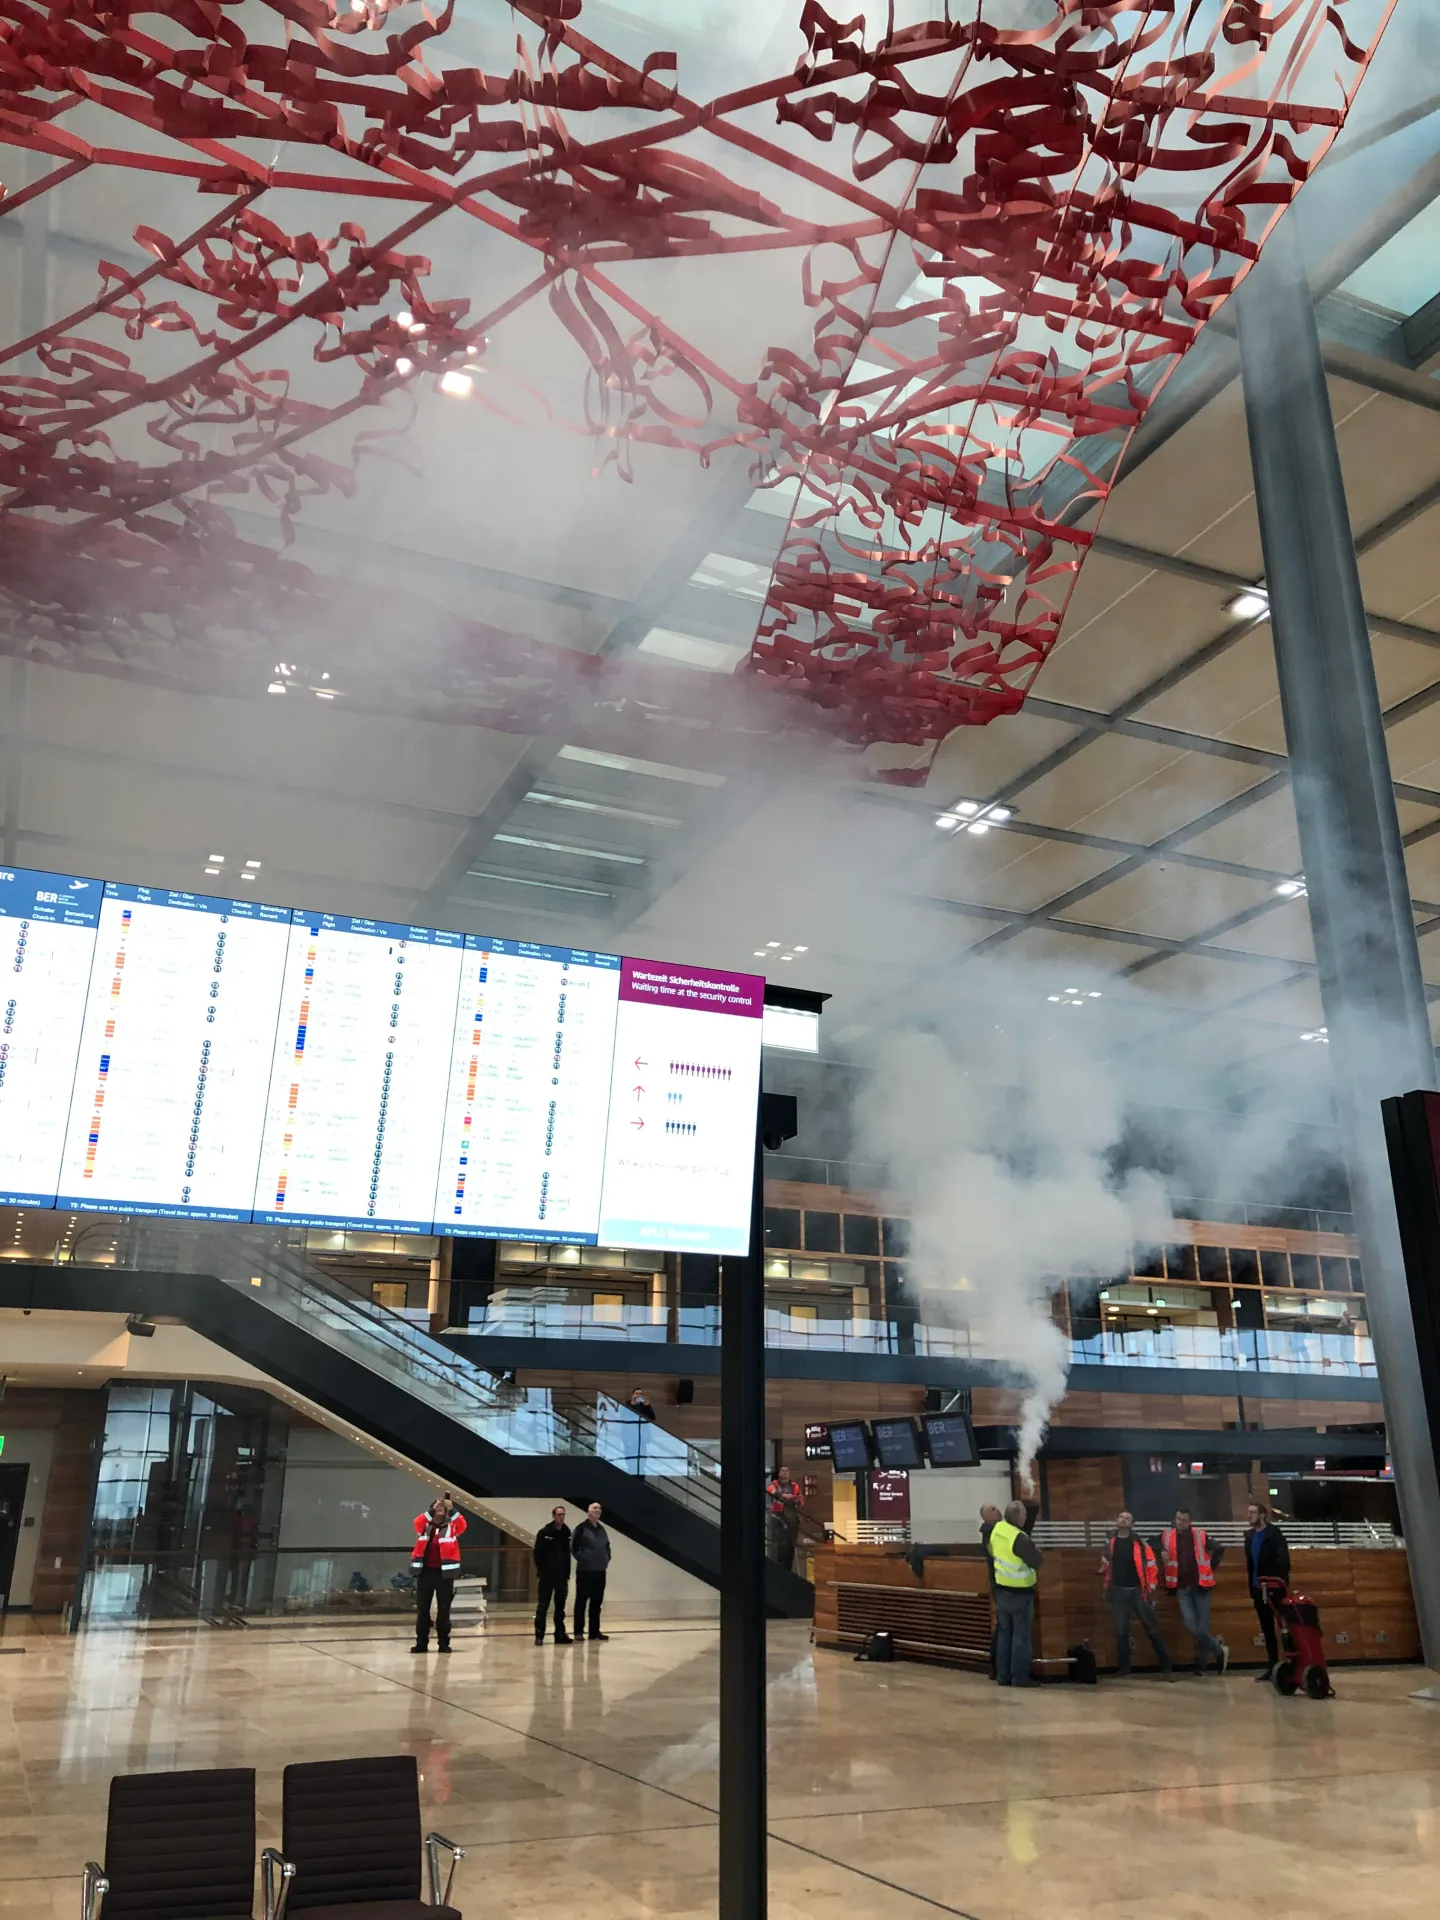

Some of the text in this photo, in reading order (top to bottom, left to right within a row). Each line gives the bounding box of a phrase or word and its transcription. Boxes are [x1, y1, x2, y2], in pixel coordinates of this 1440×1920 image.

[0, 872, 15, 882] re
[36, 890, 58, 903] BER
[168, 899, 195, 908] Destination
[33, 906, 55, 914] Schalter
[64, 910, 94, 920] Bemerkung
[231, 908, 252, 916] Check-in
[32, 913, 55, 921] Check-in
[64, 917, 84, 925] Remark
[632, 971, 740, 992] Wartezeit Sicherheitskontrolle
[632, 982, 658, 994] Waiting
[660, 986, 676, 995] time
[686, 989, 698, 998] the
[700, 992, 727, 1003] security
[728, 995, 752, 1005] control
[927, 1422, 945, 1434] BER
